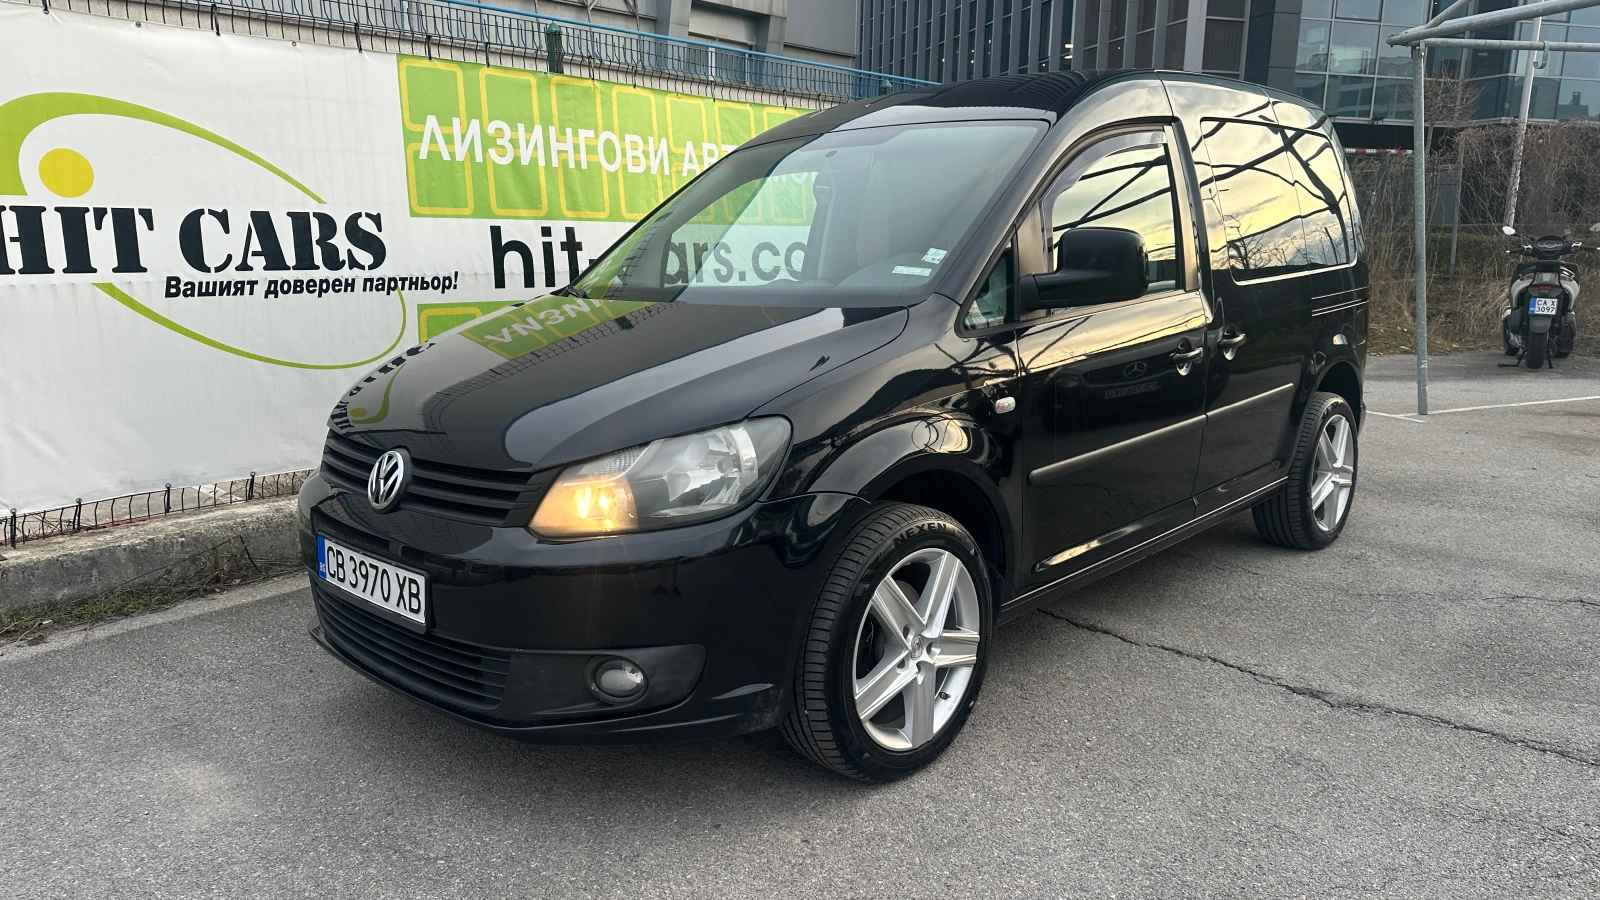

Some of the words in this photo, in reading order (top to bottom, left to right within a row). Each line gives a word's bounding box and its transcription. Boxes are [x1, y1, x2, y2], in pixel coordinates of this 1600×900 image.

[419, 115, 671, 176] ЛИЗИНГОВИ
[0, 205, 154, 275] HIT
[179, 208, 387, 273] CARS
[164, 275, 258, 298] Вашият
[264, 276, 356, 299] доверен
[362, 270, 459, 296] партньор!
[893, 522, 946, 546] NEXEN
[326, 545, 346, 584] CB
[349, 555, 391, 603] 3970
[395, 572, 421, 615] XB
